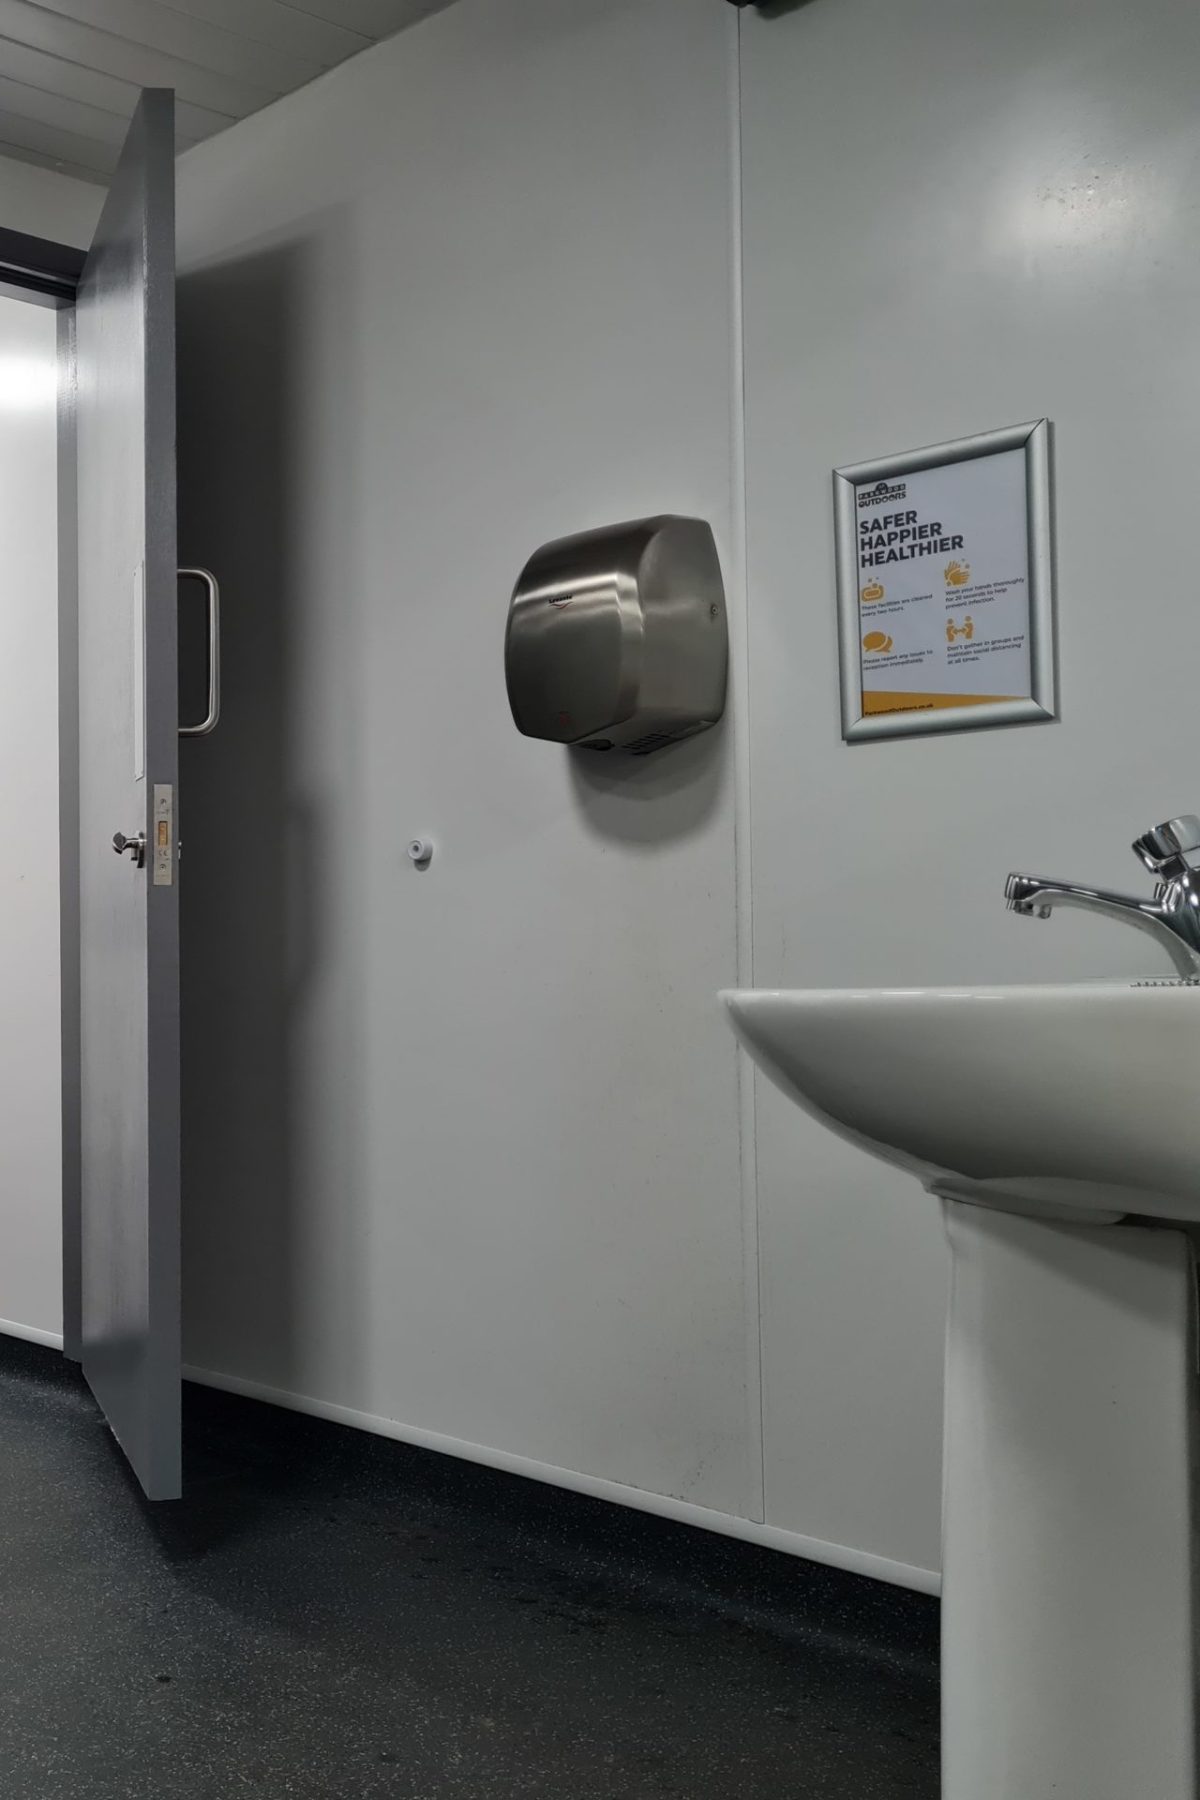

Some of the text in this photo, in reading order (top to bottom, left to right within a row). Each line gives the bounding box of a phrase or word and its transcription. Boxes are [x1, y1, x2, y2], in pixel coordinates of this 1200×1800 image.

[859, 491, 906, 507] OUTDOORS
[860, 510, 917, 535] SAFER
[861, 522, 942, 551] HAPPIER
[861, 535, 964, 568] HEALTHIER
[993, 577, 1024, 587] thoroughly
